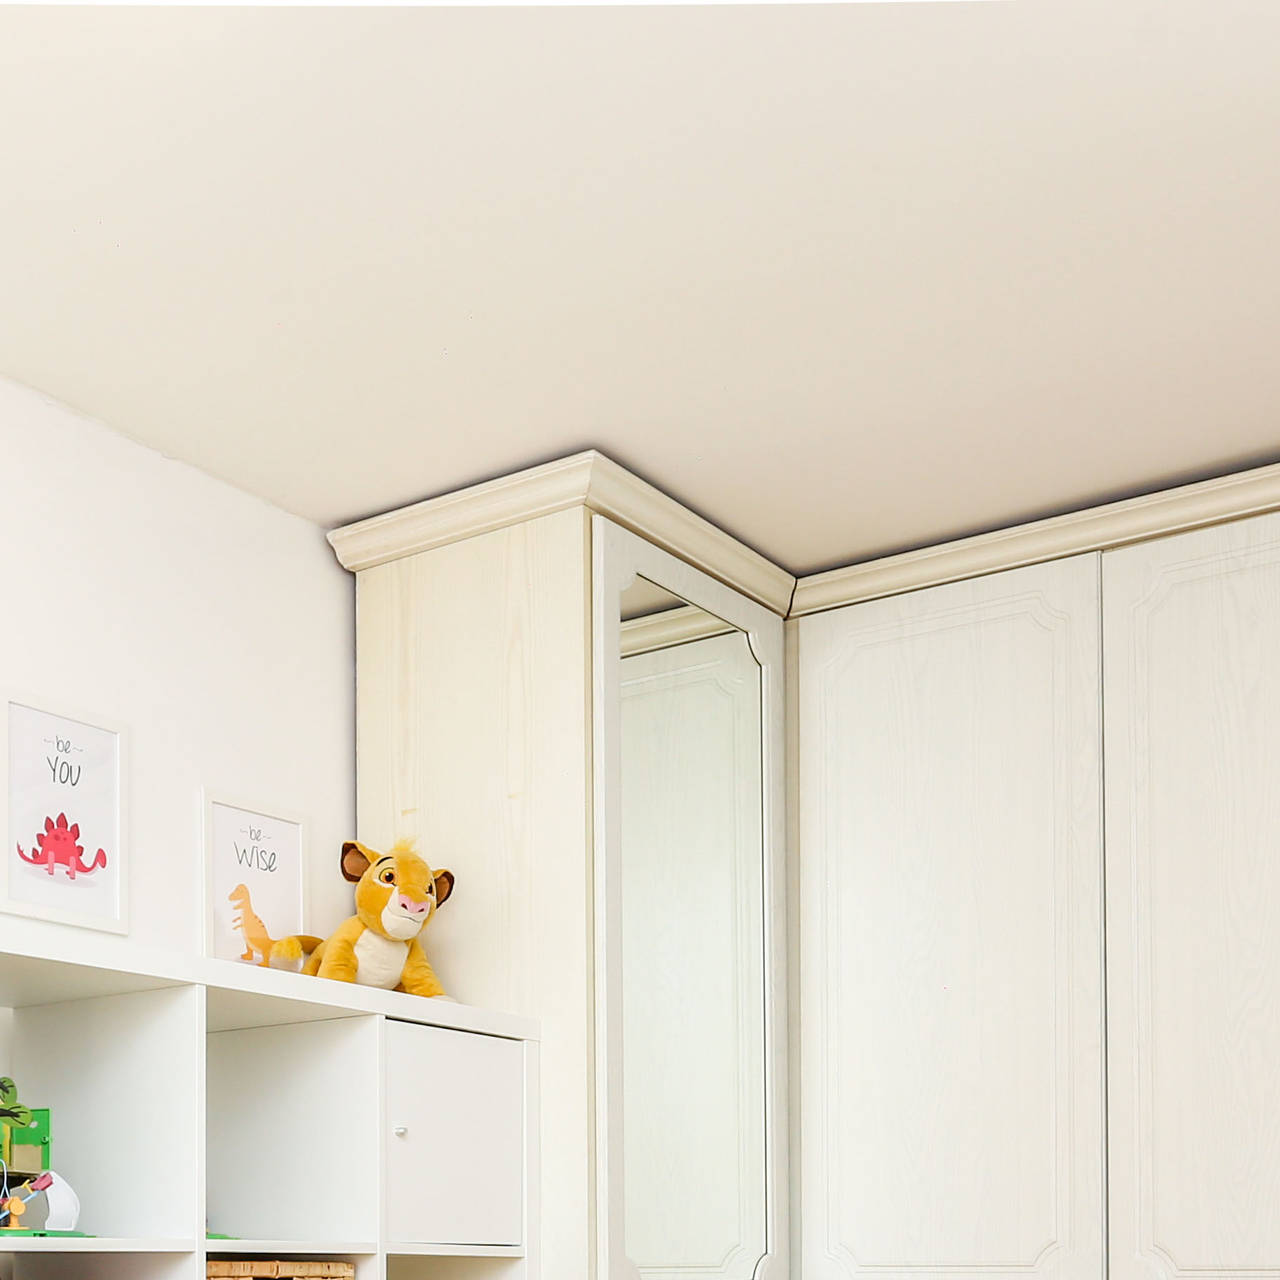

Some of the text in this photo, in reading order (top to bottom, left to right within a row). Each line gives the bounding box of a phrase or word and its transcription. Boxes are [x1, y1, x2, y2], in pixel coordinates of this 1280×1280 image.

[55, 734, 73, 755] be
[248, 825, 263, 843] be
[233, 842, 278, 874] Wise
